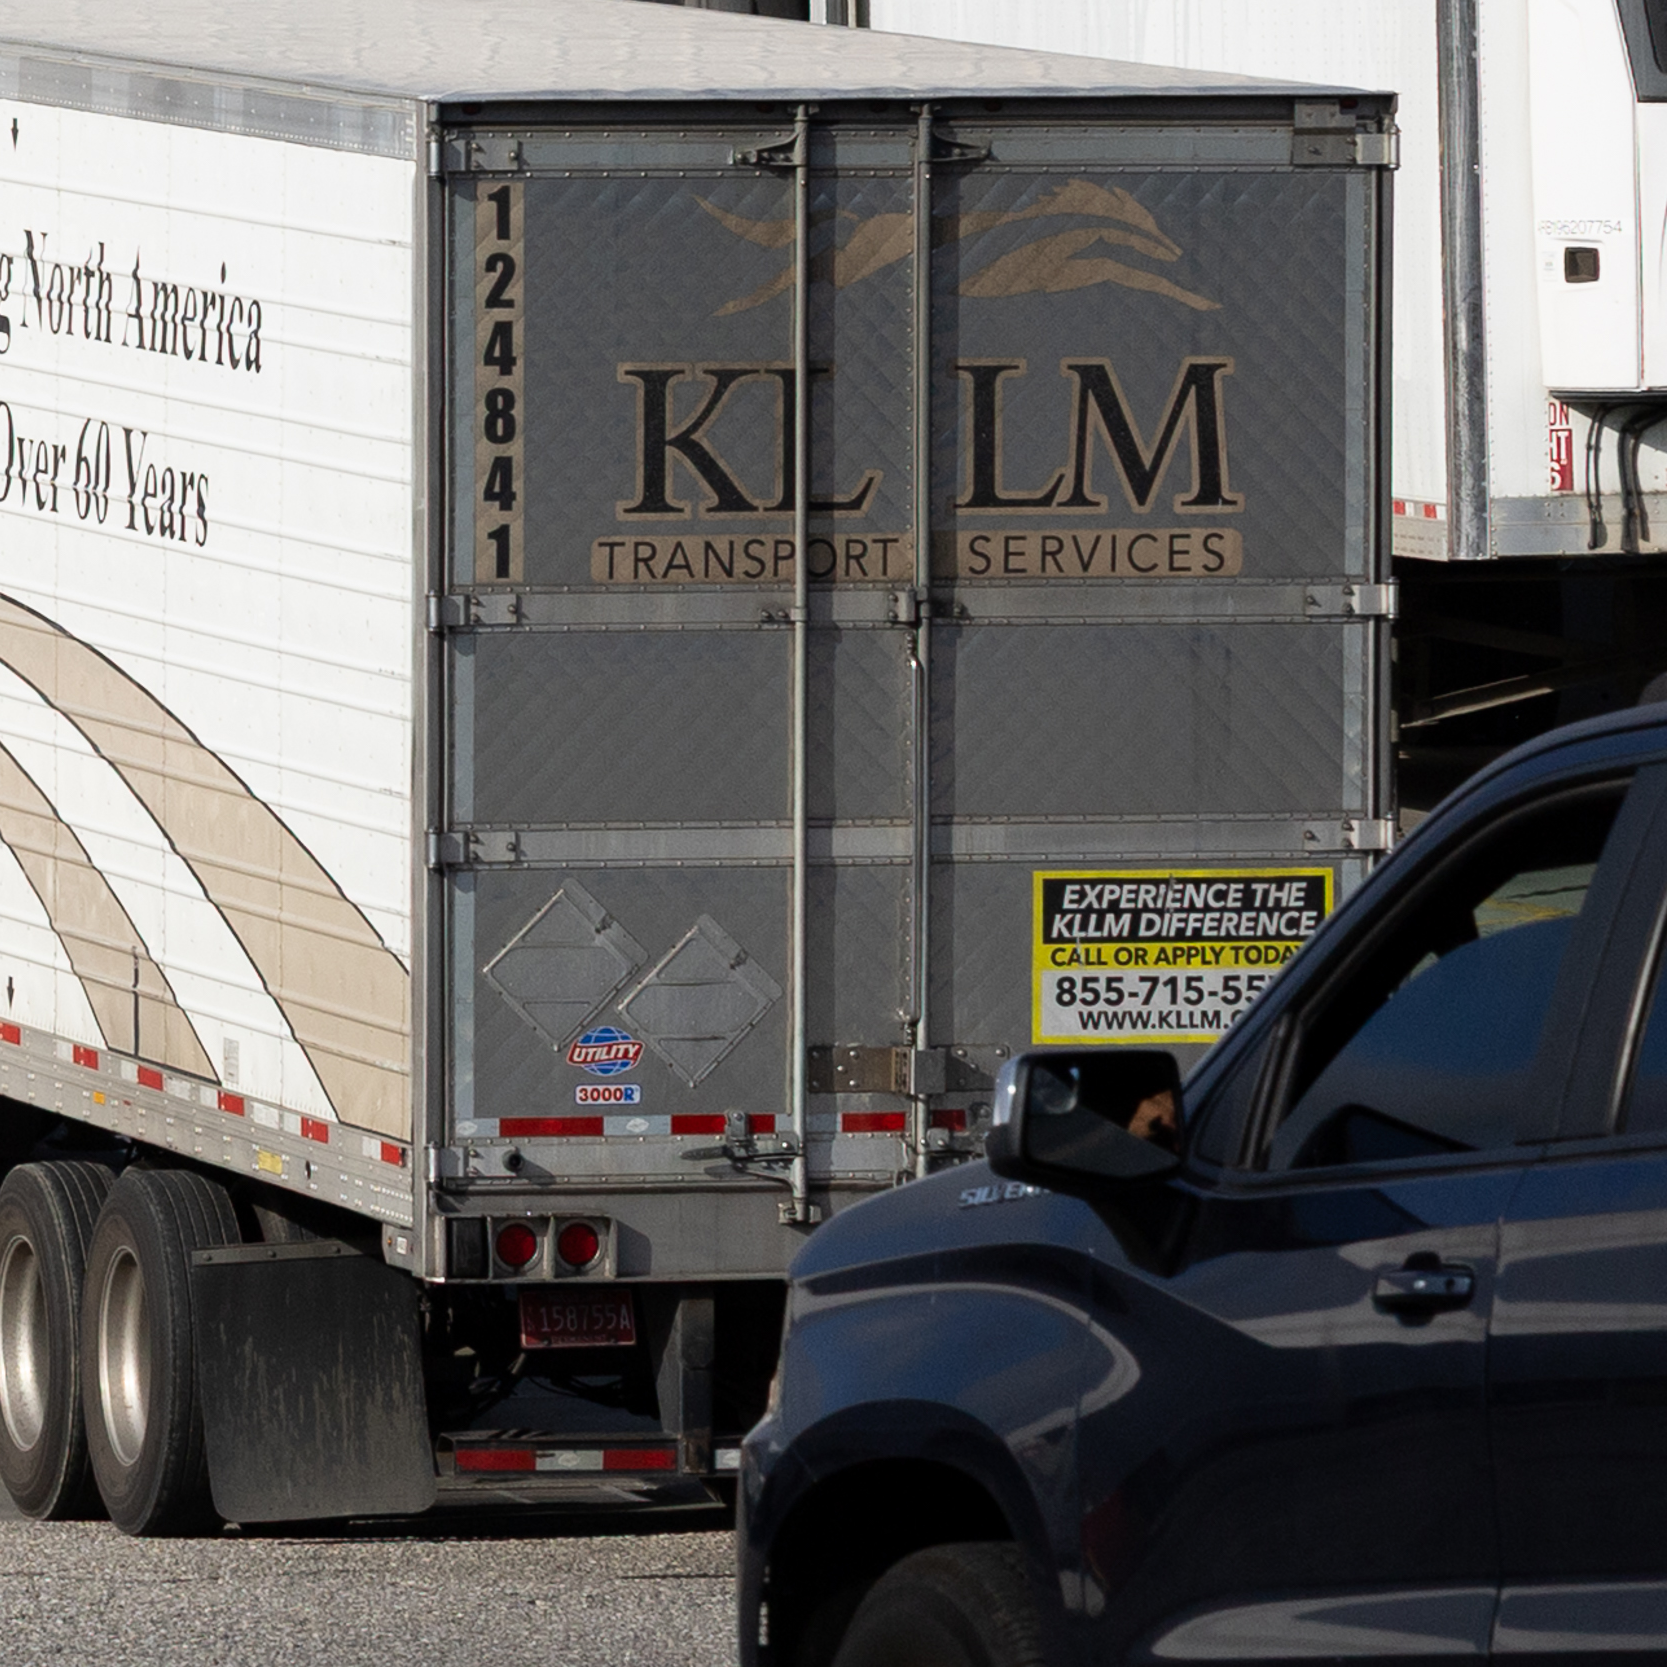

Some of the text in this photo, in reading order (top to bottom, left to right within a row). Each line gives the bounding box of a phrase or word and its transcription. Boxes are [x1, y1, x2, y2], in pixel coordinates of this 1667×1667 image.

[20, 229, 114, 344] North
[121, 245, 263, 374] America
[483, 184, 517, 580] 124841
[72, 417, 111, 524] 60
[121, 426, 209, 547] Years
[597, 532, 1227, 581] TRANSPORT SERVICES
[1062, 881, 1308, 910] EXPERIENCE THE
[1050, 911, 1319, 939] KLLM DIFFERENCE
[1050, 947, 1108, 966] CALL
[1113, 946, 1149, 966] OR
[1153, 945, 1226, 966] APPLY
[1055, 975, 1273, 1008] 855-715-55
[572, 1043, 640, 1063] UTILITY
[539, 1303, 631, 1333] 158755A
